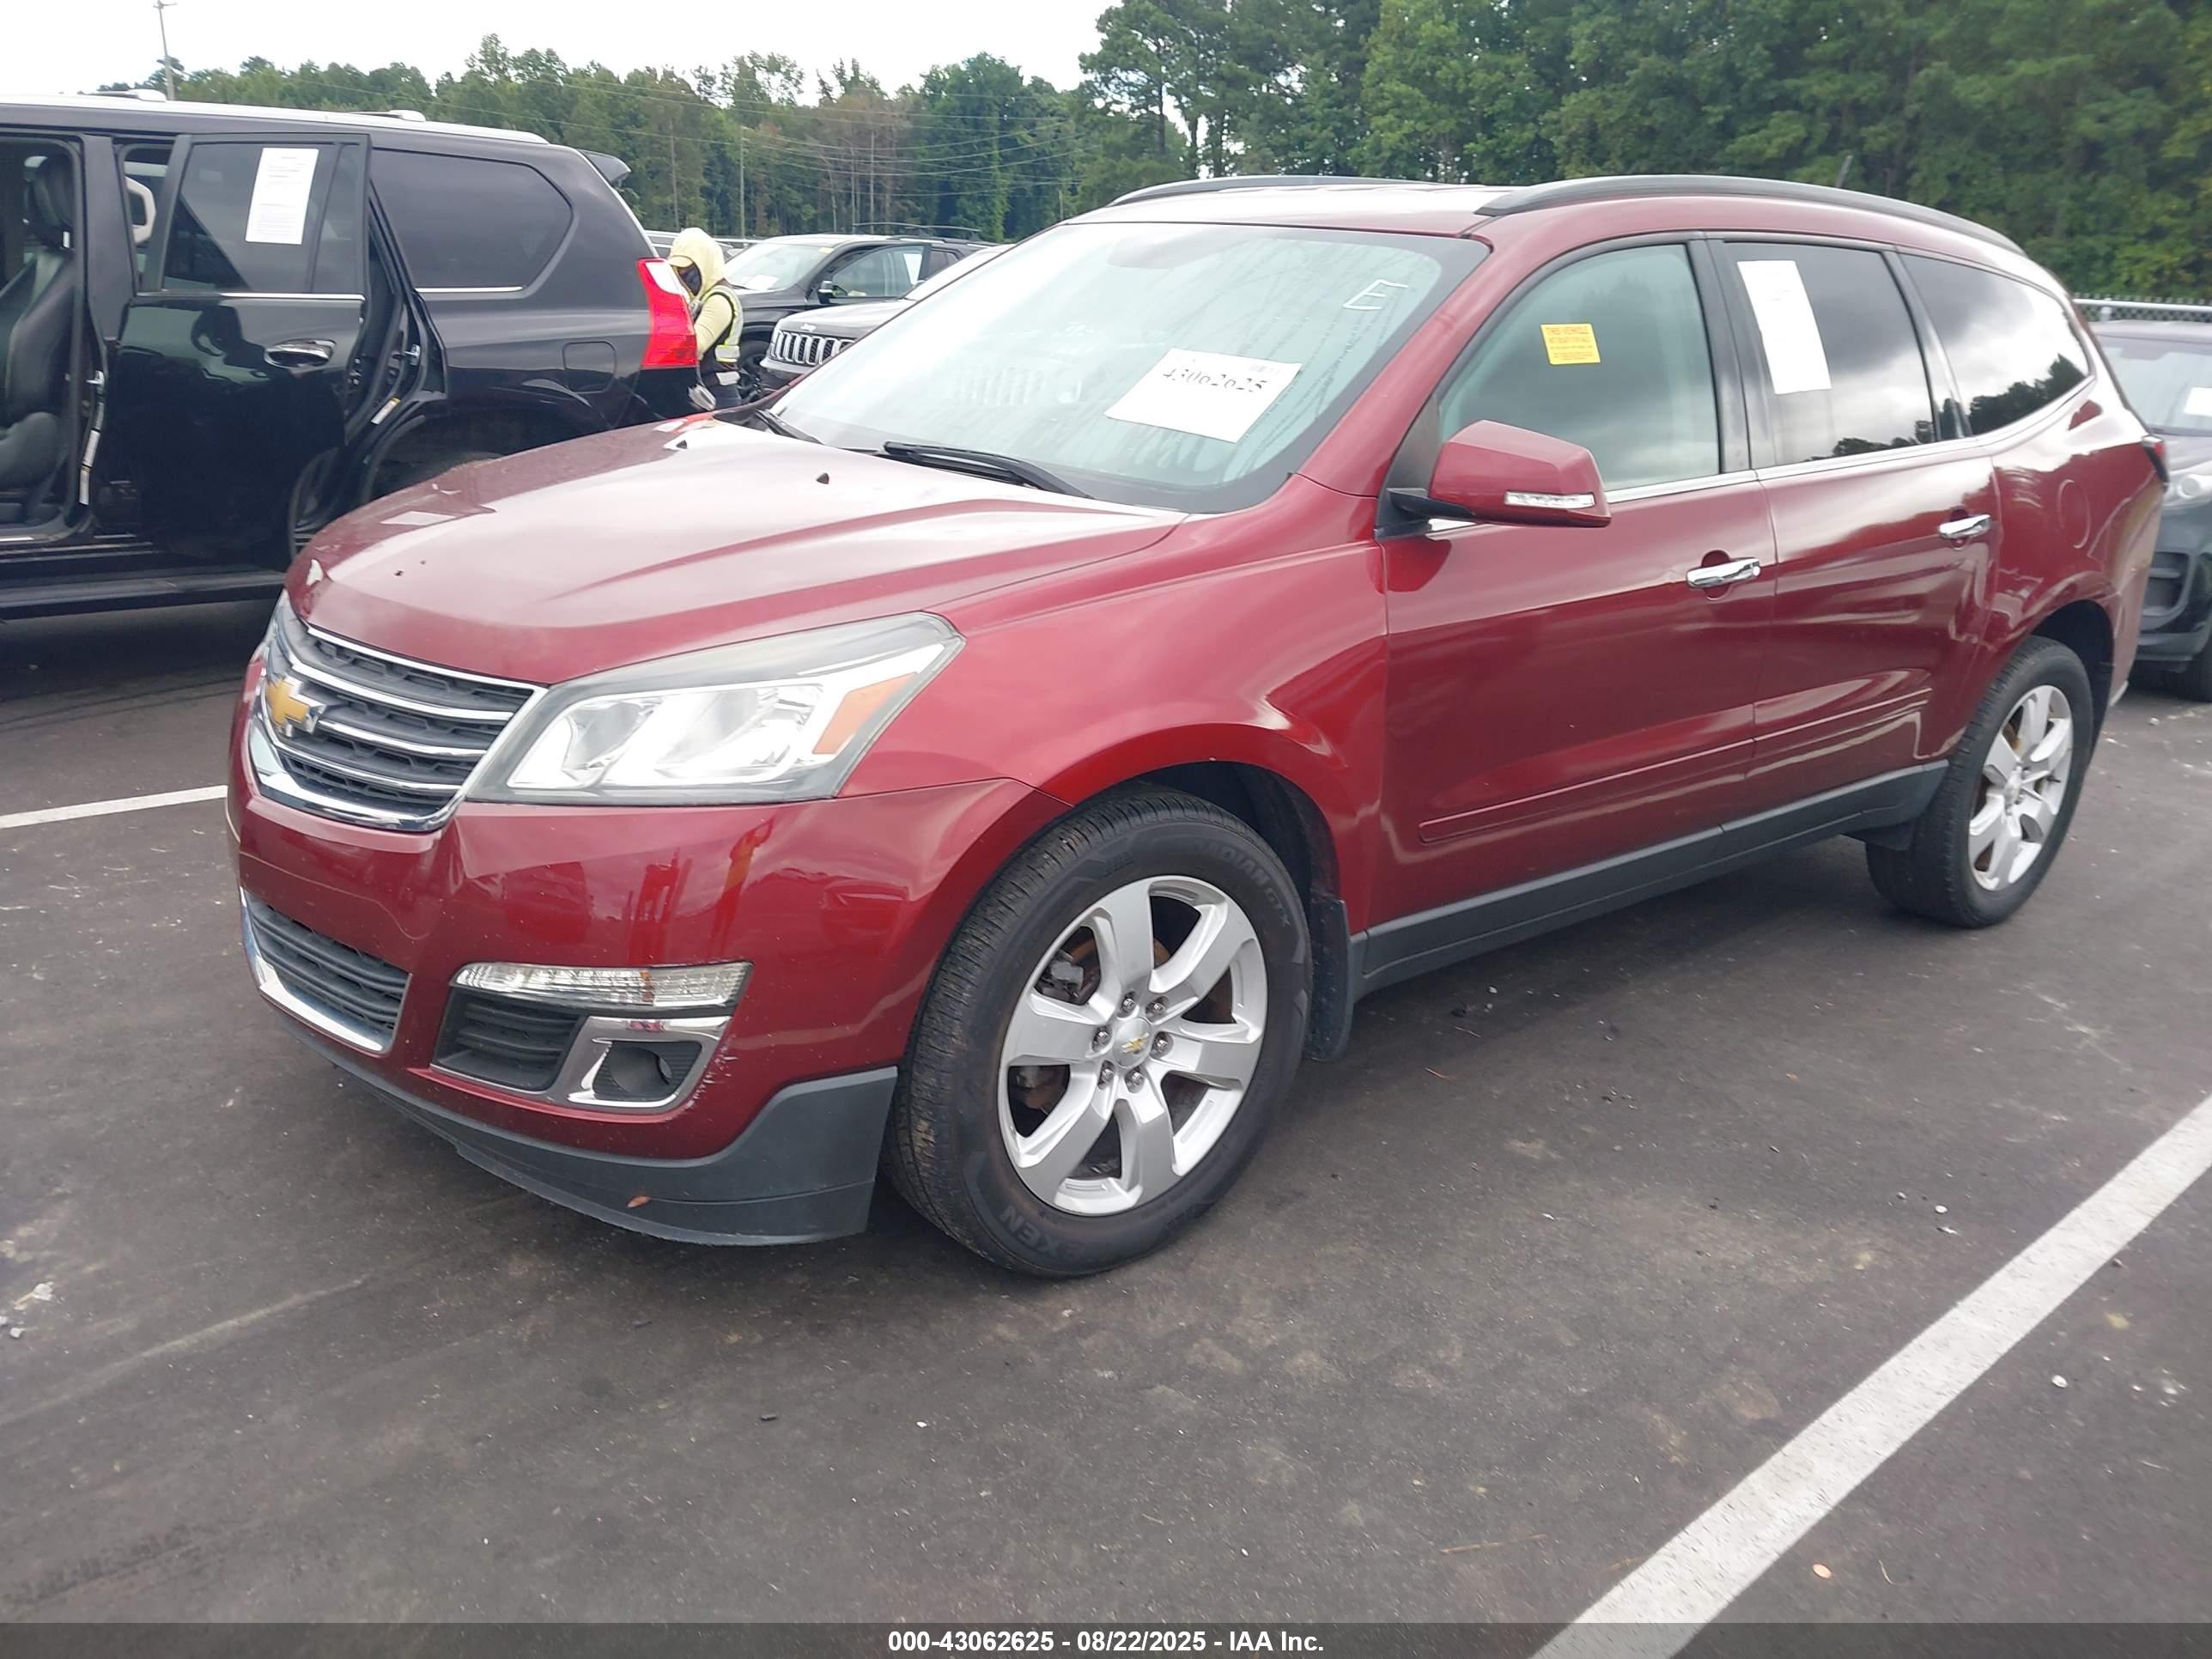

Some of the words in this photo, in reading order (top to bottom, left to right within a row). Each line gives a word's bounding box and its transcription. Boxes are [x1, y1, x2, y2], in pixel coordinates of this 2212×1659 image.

[1342, 279, 1408, 310] E
[800, 323, 817, 332] Jp
[999, 1204, 1089, 1261] EXEN
